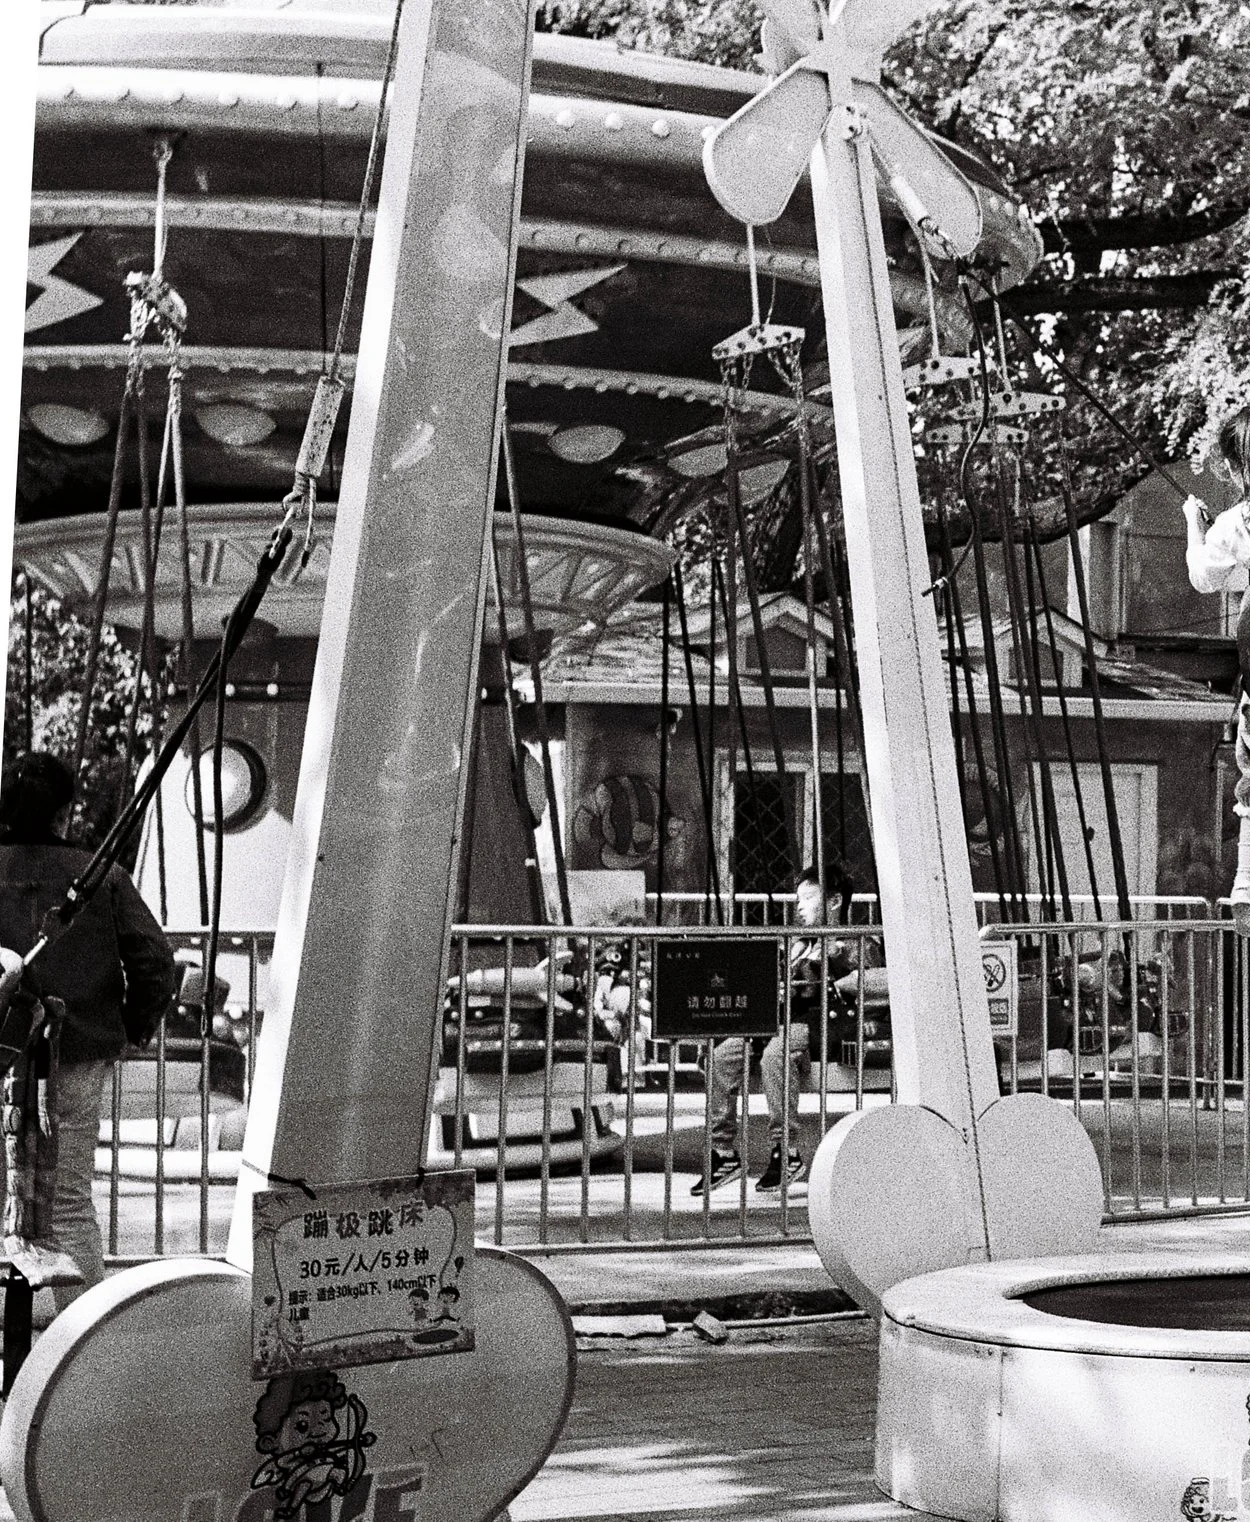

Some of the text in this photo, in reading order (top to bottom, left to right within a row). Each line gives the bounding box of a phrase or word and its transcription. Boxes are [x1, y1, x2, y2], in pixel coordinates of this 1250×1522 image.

[687, 994, 748, 1009] 请勿翻越
[303, 1201, 424, 1240] 蹦极跳床
[300, 1246, 430, 1280] 30元/人/5分钟
